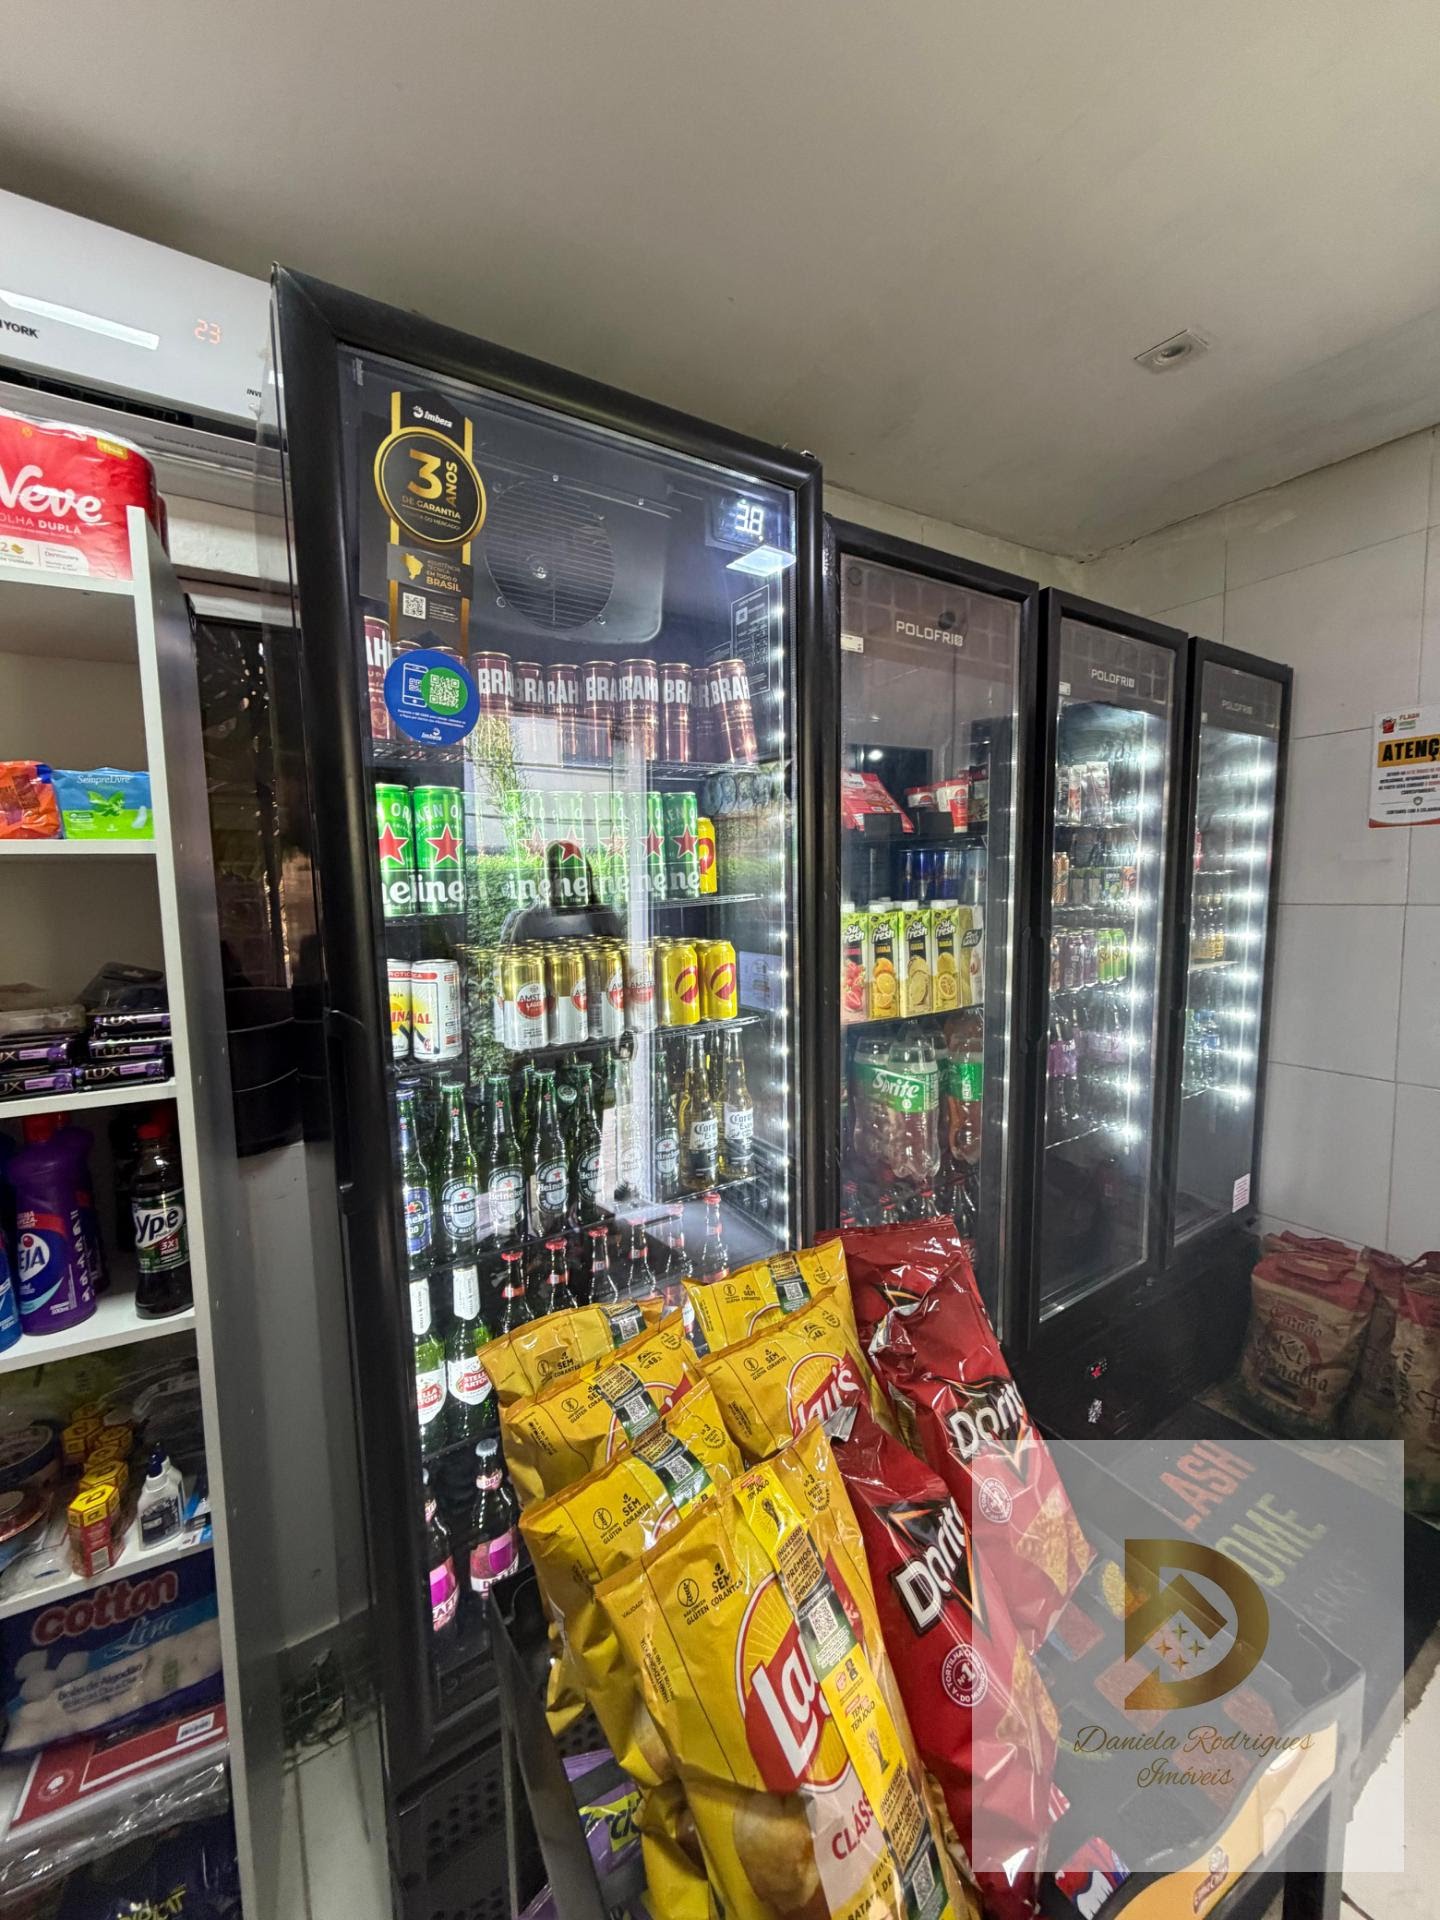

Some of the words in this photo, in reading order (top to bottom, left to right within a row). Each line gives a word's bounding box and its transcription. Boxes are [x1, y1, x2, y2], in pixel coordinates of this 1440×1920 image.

[194, 319, 221, 344] 23
[407, 448, 443, 500] 3
[445, 460, 458, 507] ANOS
[416, 501, 462, 520] GARANTIA
[38, 519, 82, 536] DUPLA
[426, 576, 462, 593] BRASIL
[85, 1066, 119, 1081] LUX
[872, 1076, 920, 1099] Sprite
[557, 1359, 574, 1370] SEM
[764, 1353, 782, 1365] SEM
[621, 1497, 642, 1518] SEM
[602, 1525, 623, 1545] GLUTEN
[622, 1502, 651, 1528] CORANTES
[711, 1571, 732, 1594] SEM
[686, 1604, 710, 1626] GLUTEN
[710, 1579, 744, 1607] CORANTES
